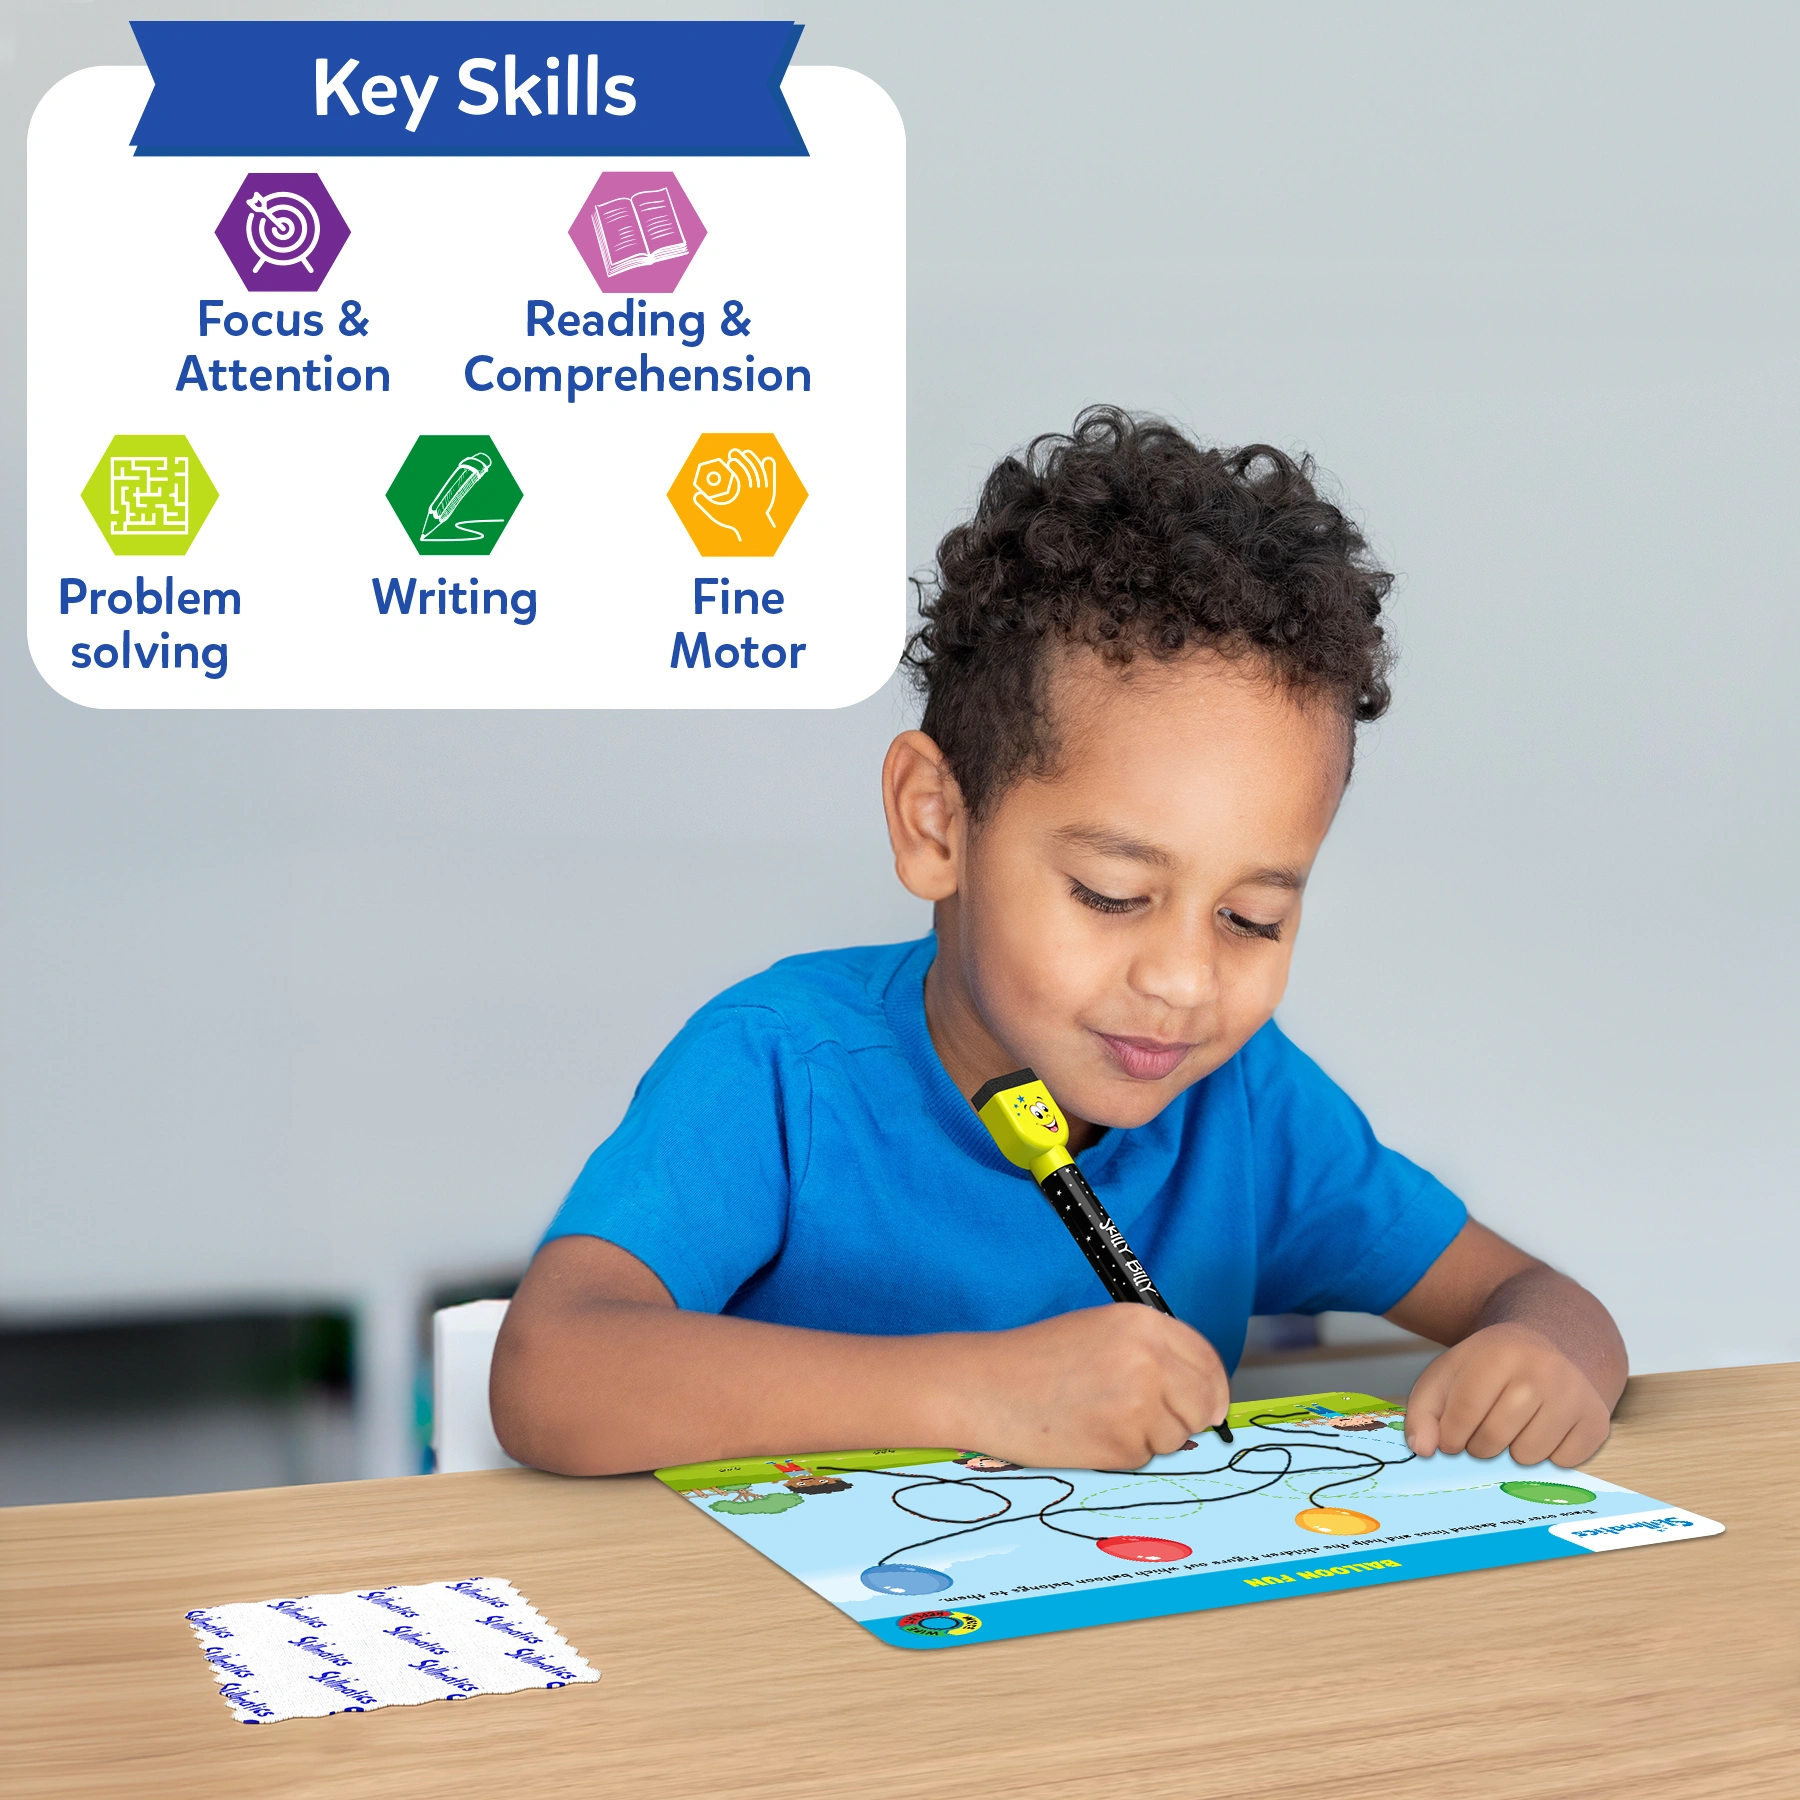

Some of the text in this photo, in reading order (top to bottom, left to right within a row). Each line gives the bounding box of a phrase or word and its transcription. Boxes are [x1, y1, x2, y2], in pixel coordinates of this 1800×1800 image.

[1528, 1514, 1557, 1522] over
[1559, 1509, 1598, 1518] Trace
[1500, 1518, 1526, 1526] the
[1571, 1516, 1694, 1537] Skillmatics
[1449, 1521, 1498, 1534] dashed
[1387, 1533, 1412, 1542] and
[1414, 1528, 1450, 1538] lines
[1323, 1541, 1350, 1551] the
[1351, 1538, 1388, 1548] help
[1261, 1547, 1321, 1560] children
[1183, 1561, 1208, 1570] out
[1135, 1566, 1179, 1577] which
[1243, 1559, 1403, 1588] BALLOON FUN
[1075, 1573, 1133, 1584] balloon
[1011, 1580, 1075, 1594] belongs
[989, 1589, 1008, 1597] to
